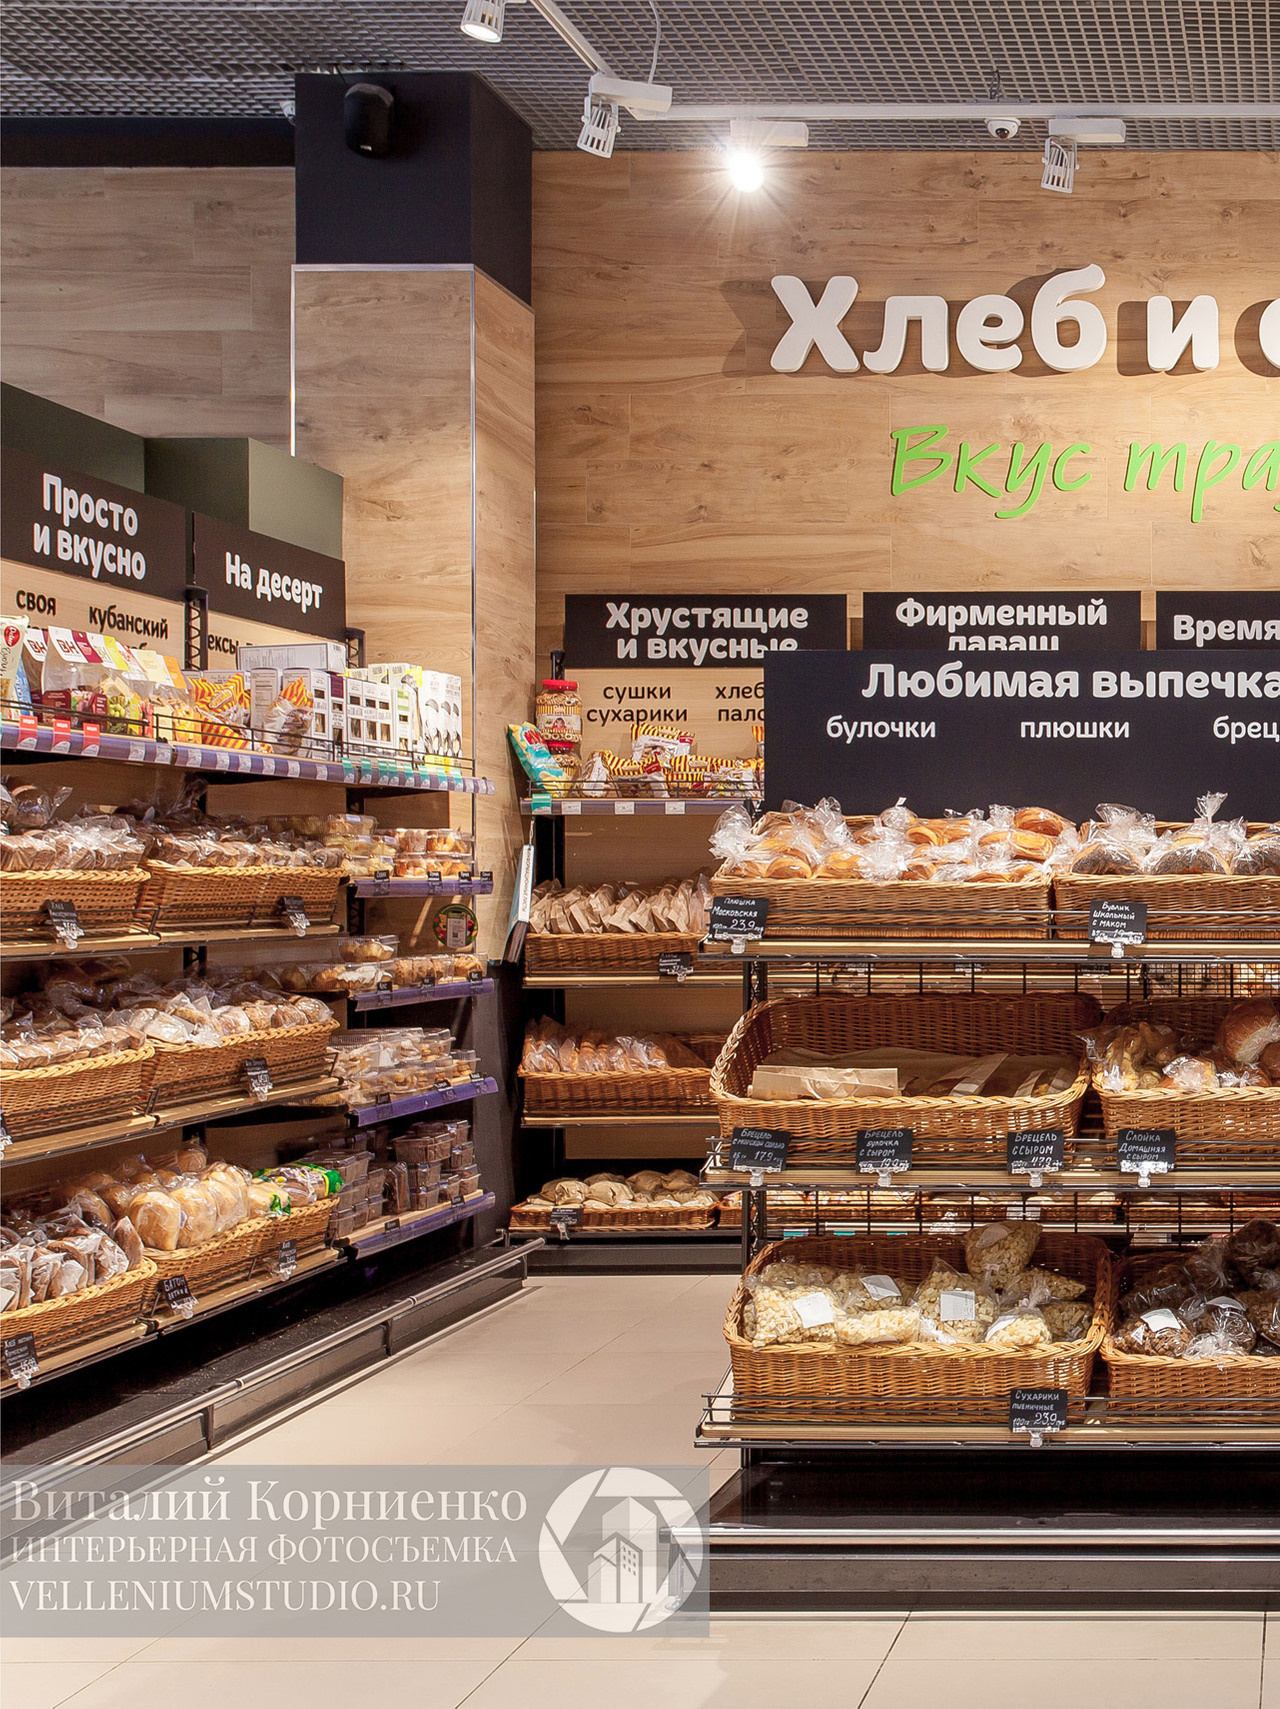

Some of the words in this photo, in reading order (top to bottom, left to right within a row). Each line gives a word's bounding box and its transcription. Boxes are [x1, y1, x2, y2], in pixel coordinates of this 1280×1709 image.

[770, 264, 1106, 374] Хлеб
[1147, 295, 1220, 373] и
[890, 424, 1092, 520] Вкус
[43, 473, 138, 536] Просто
[33, 524, 51, 556] и
[57, 530, 146, 580] вкусно
[225, 552, 252, 592] На
[256, 564, 323, 614] десерт
[16, 589, 57, 616] своя
[606, 602, 809, 635] Хрустящие
[895, 598, 1108, 633] Фирменный
[88, 604, 169, 640] кубанский
[207, 633, 238, 655] ексы
[617, 638, 637, 659] и
[647, 637, 799, 666] вкусные
[603, 684, 672, 704] сушки
[715, 682, 765, 700] хлеб
[862, 661, 1080, 699] Любимая
[587, 706, 688, 727] сухарики
[826, 715, 937, 744] булочки
[1020, 718, 1130, 739] плюшки
